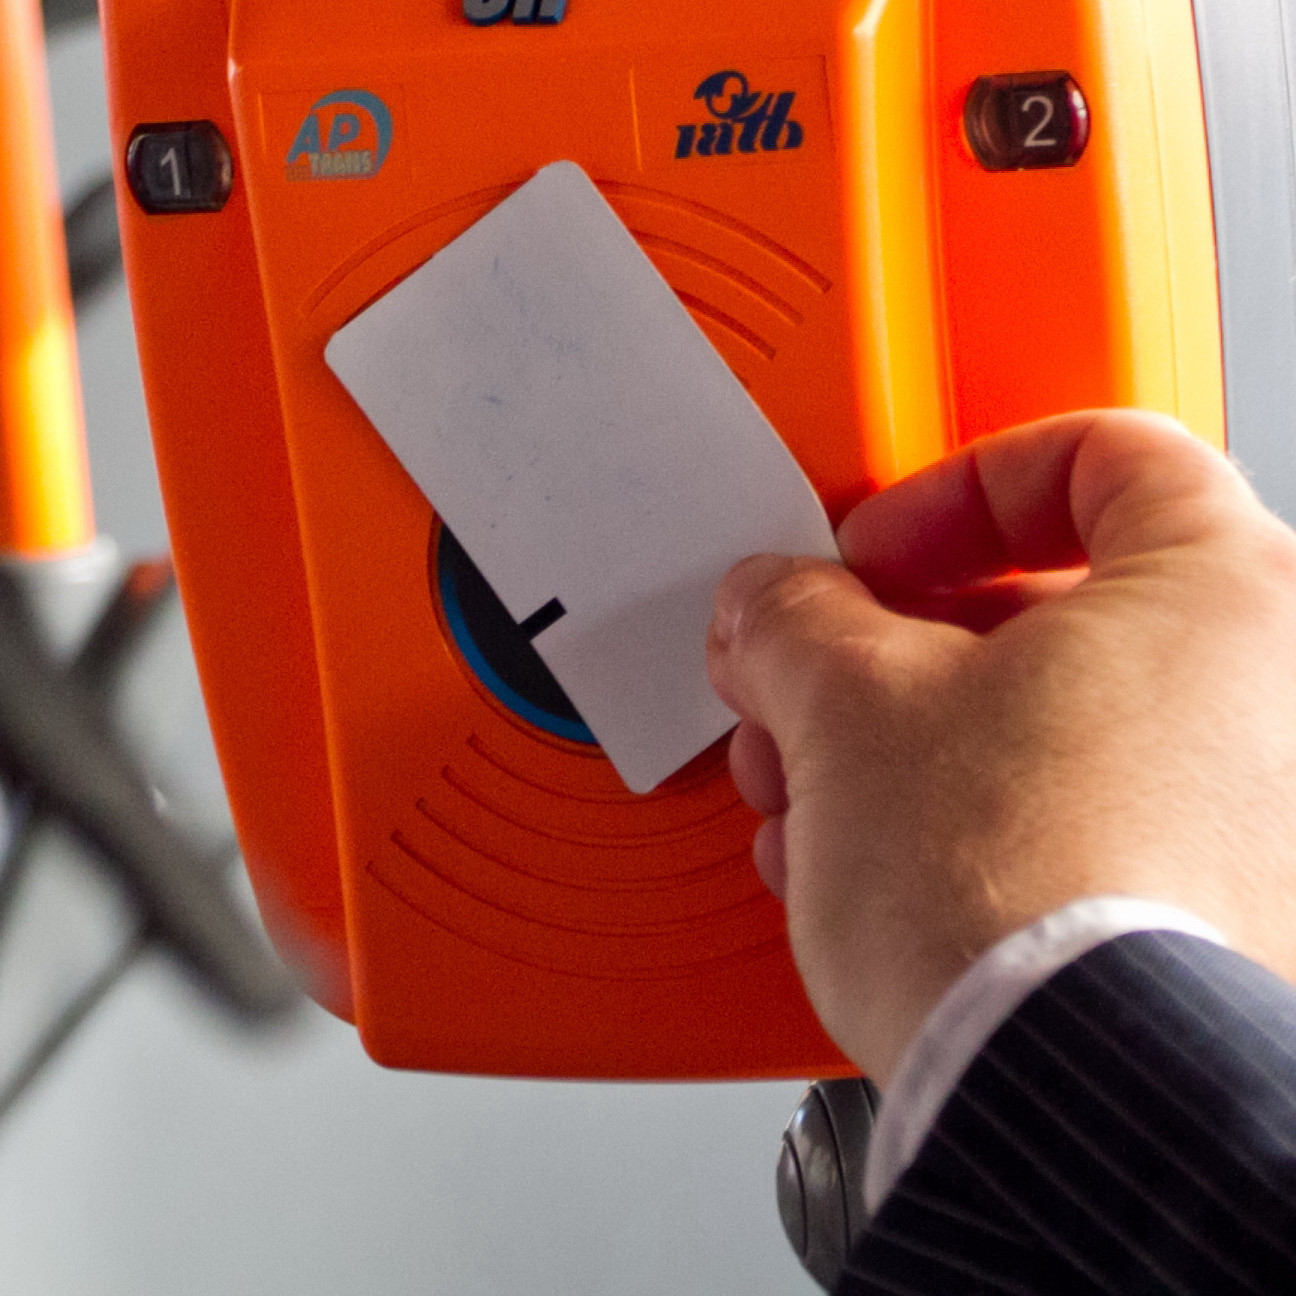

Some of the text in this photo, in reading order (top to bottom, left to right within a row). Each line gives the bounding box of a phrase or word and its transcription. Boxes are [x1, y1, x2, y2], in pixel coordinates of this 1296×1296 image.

[286, 112, 362, 164] AP
[1021, 95, 1057, 147] 2
[160, 147, 181, 196] 1
